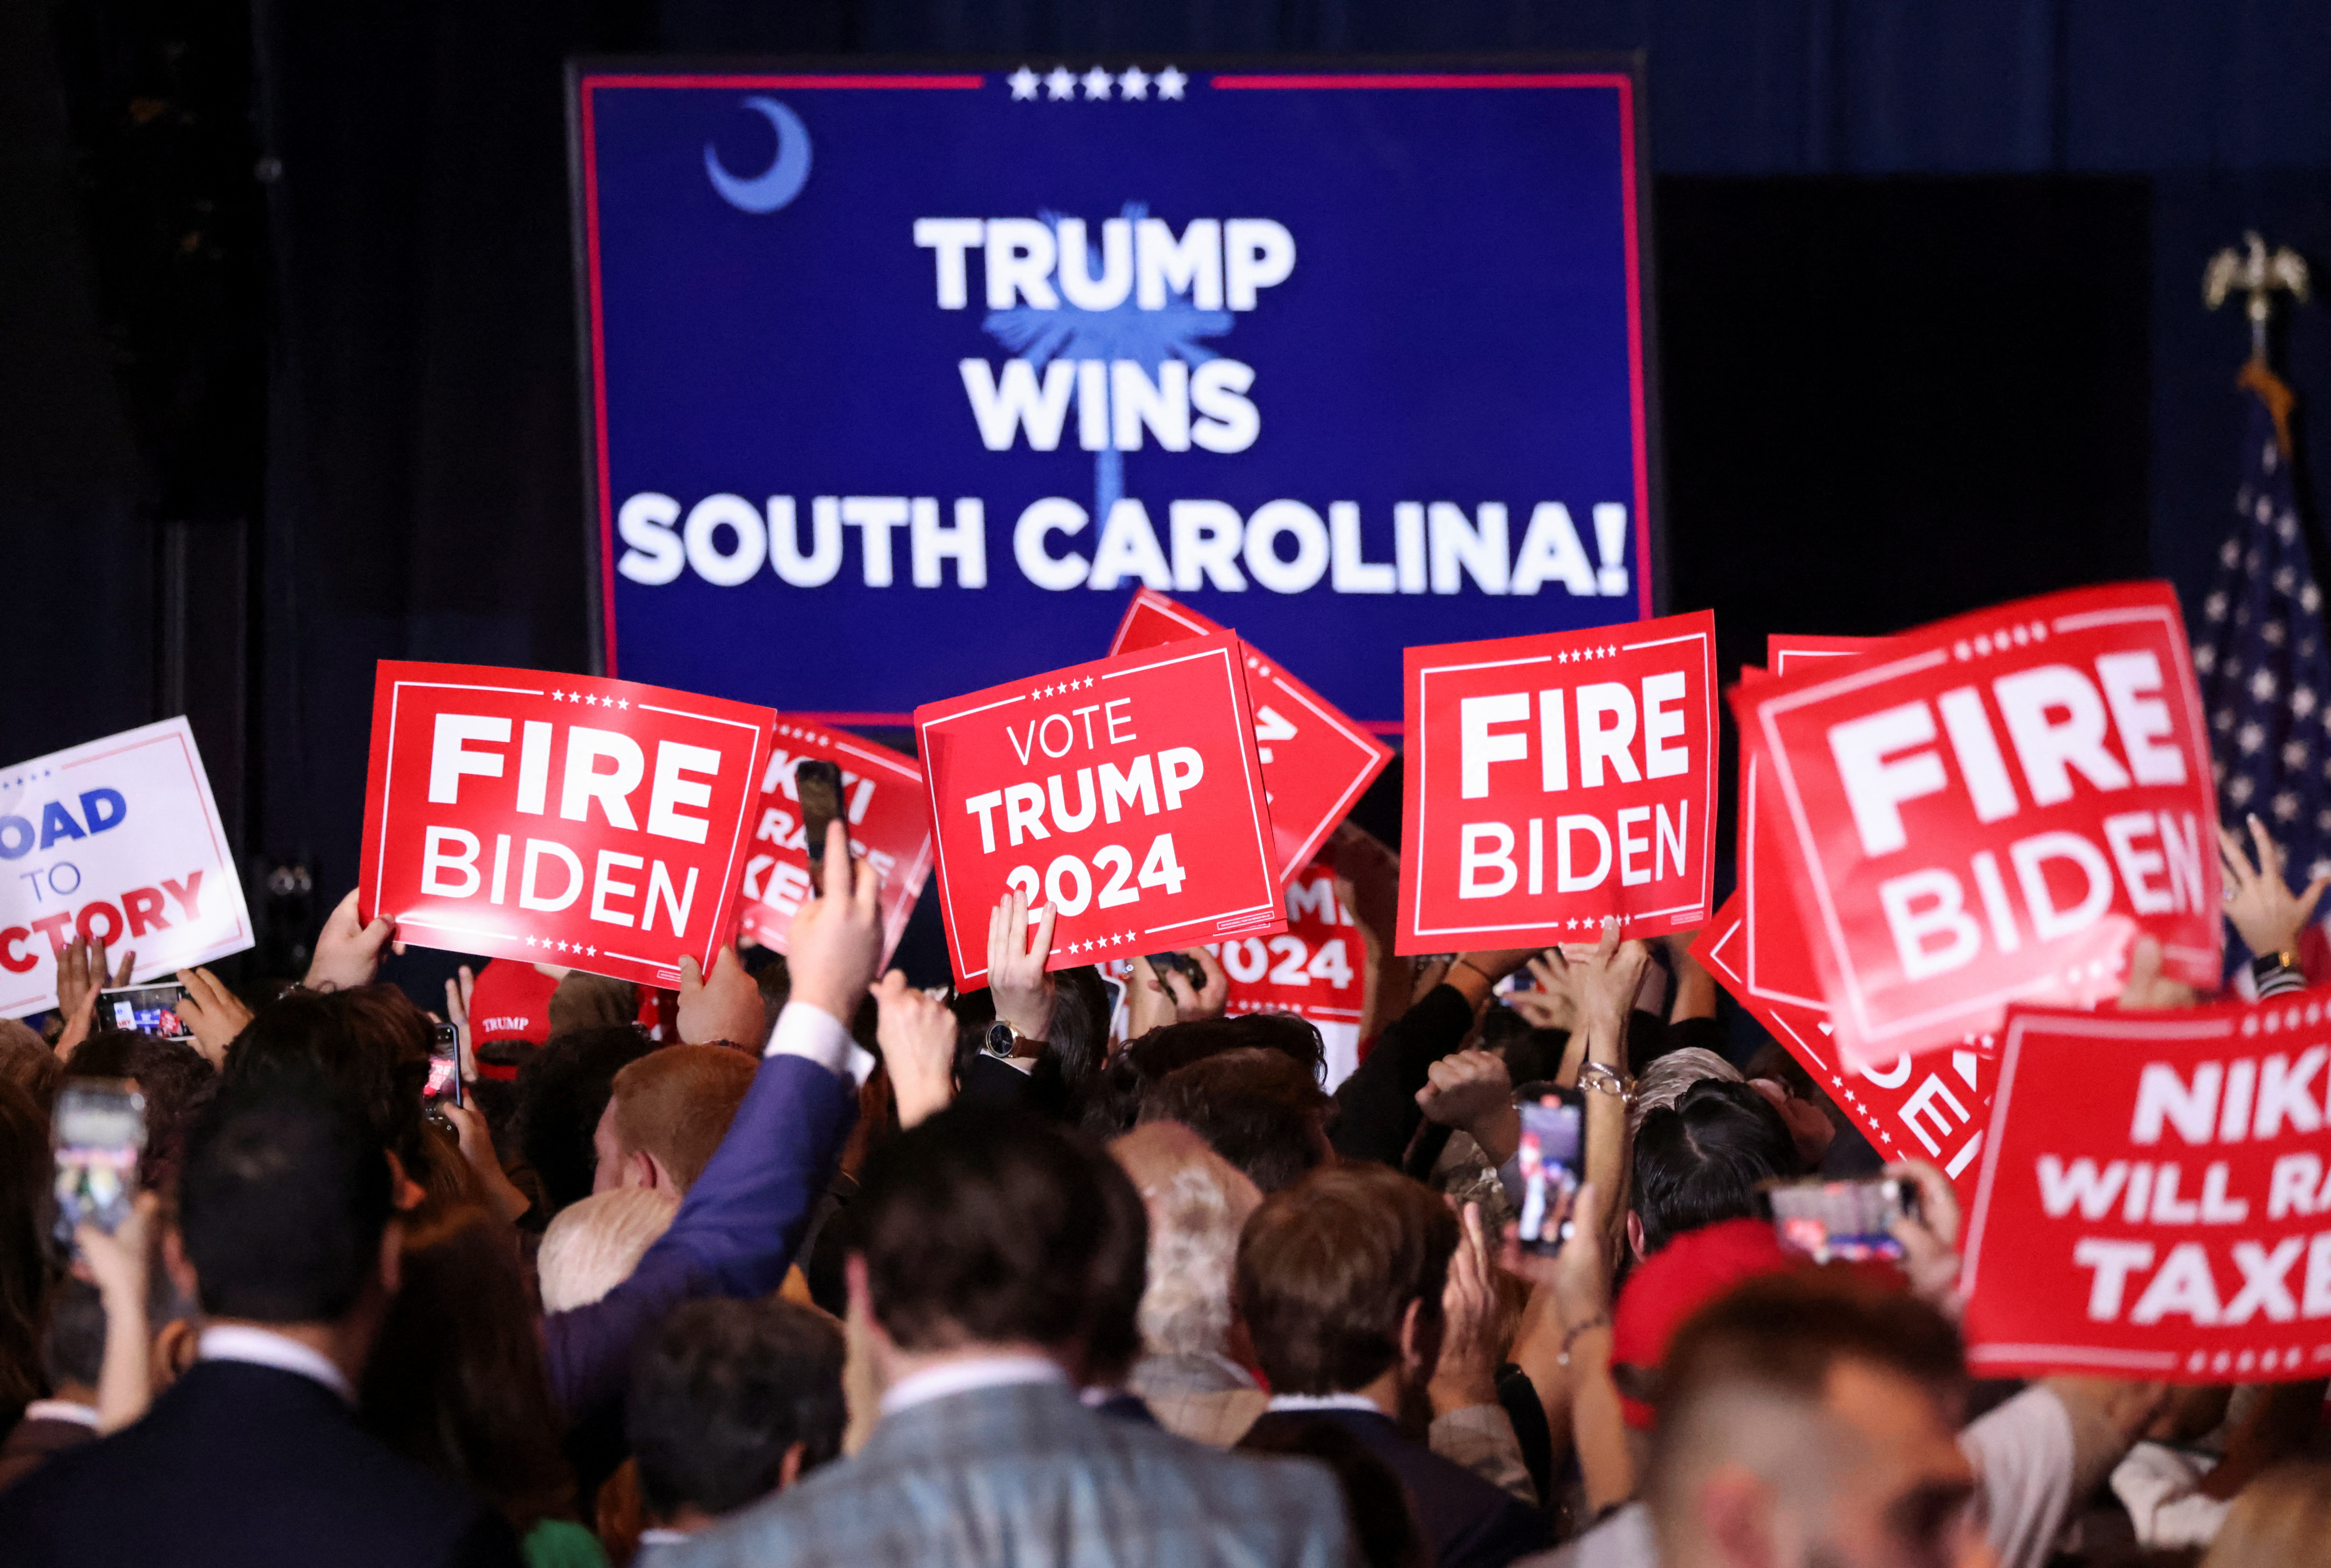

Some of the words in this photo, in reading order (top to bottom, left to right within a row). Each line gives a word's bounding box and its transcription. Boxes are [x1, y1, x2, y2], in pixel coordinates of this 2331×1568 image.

[913, 218, 1297, 310] TRUMP
[959, 358, 1261, 454] WINS
[618, 493, 987, 589] SOUTH
[1013, 497, 1629, 597] CAROLINA!
[428, 713, 722, 844] FIRE
[1007, 697, 1137, 765] VOTE
[1461, 671, 1689, 799] FIRE
[1828, 650, 2187, 859] FIRE
[0, 787, 127, 860] OAD
[966, 747, 1204, 854] TRUMP
[1459, 799, 1688, 899] BIDEN
[0, 869, 204, 974] CTORY
[20, 861, 82, 902] TO
[421, 825, 699, 938] BIDEN
[1006, 833, 1186, 925] 2024
[1876, 810, 2205, 983] BIDEN
[1204, 935, 1354, 989] 024
[482, 1016, 529, 1032] TRUMP
[2131, 1044, 2331, 1144] NIK
[2036, 1154, 2249, 1224] WILL
